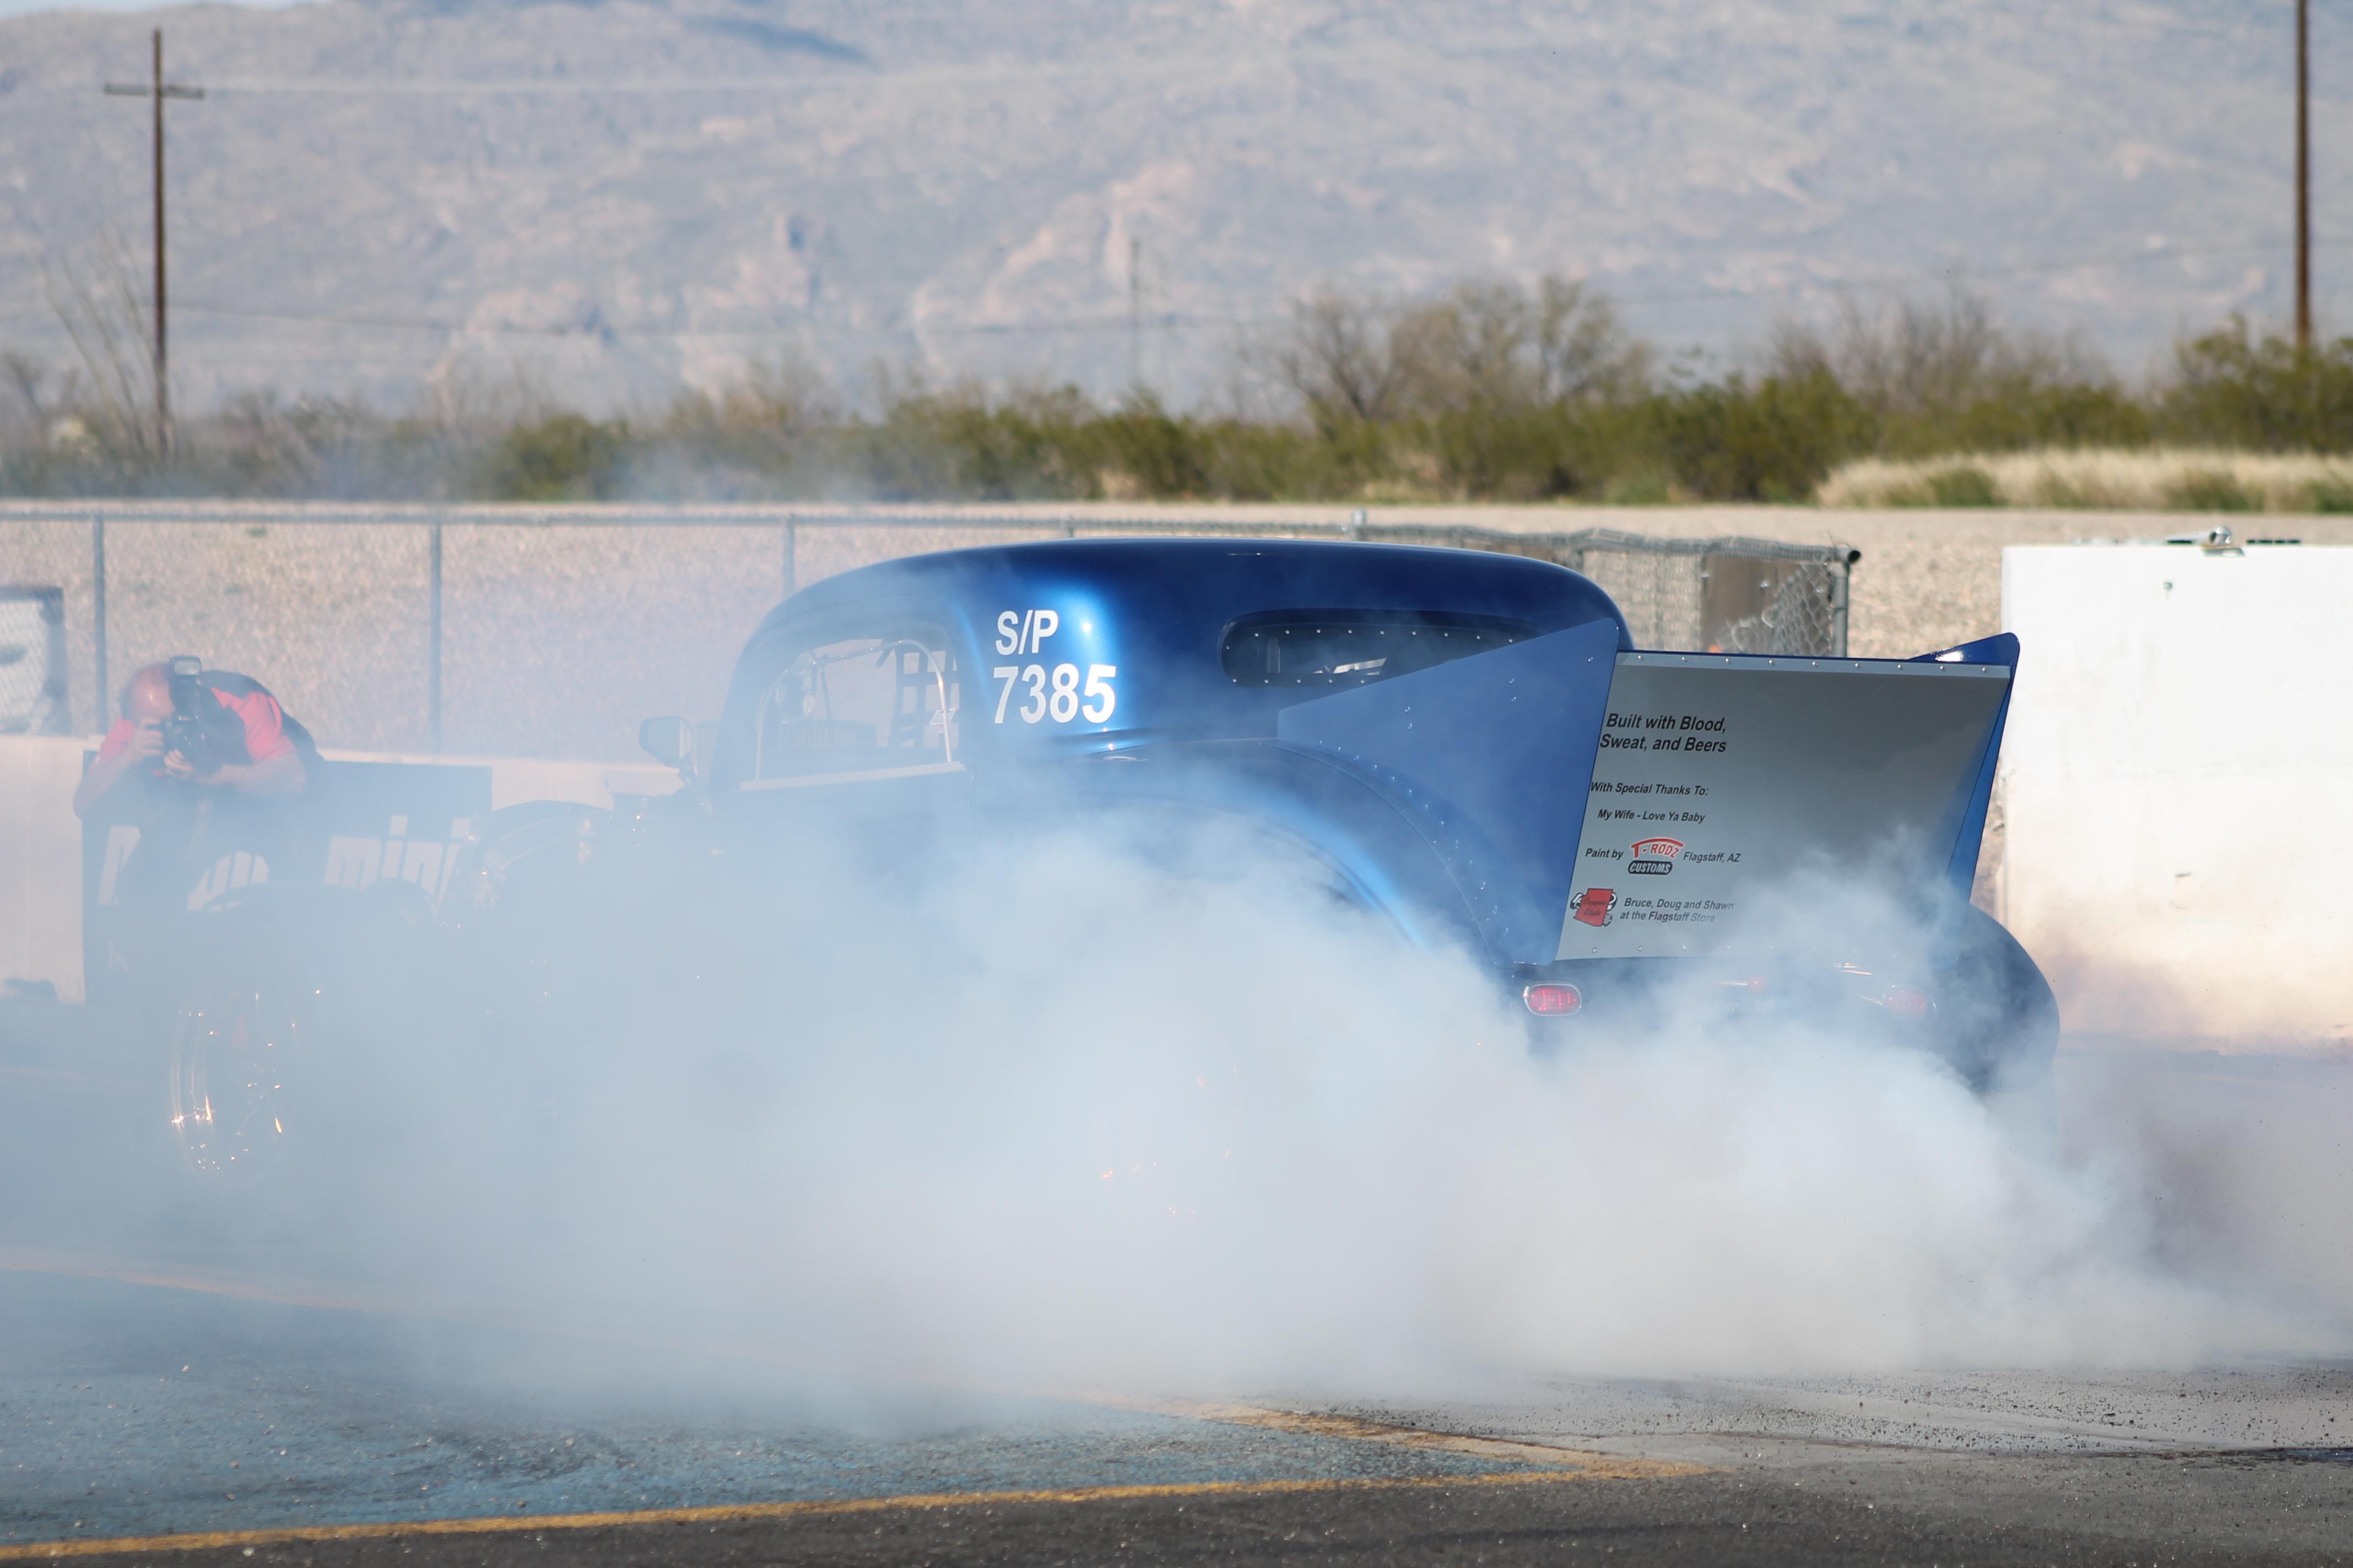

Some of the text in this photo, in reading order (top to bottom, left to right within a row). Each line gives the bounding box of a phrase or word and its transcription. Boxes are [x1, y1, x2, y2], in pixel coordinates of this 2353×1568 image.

[996, 609, 1058, 655] S/P
[993, 663, 1116, 724] 7385
[1606, 713, 1726, 734] Built with Blood,
[1599, 734, 1727, 752] Sweat, and Beers
[1590, 782, 1709, 796] With Special Thanks To:
[1597, 809, 1612, 821] My
[1614, 810, 1635, 820] Wife
[1642, 811, 1665, 821] Love
[1669, 812, 1679, 821] Ya
[1681, 812, 1706, 824] Baby
[1584, 848, 1624, 861] Paint by
[1683, 851, 1741, 863] Flagstaff, AZ
[1629, 861, 1672, 873] CUSTOMS
[1624, 898, 1734, 911] Bruce, Doug and Shawn
[1619, 911, 1715, 923] at the Flagstaff Store
